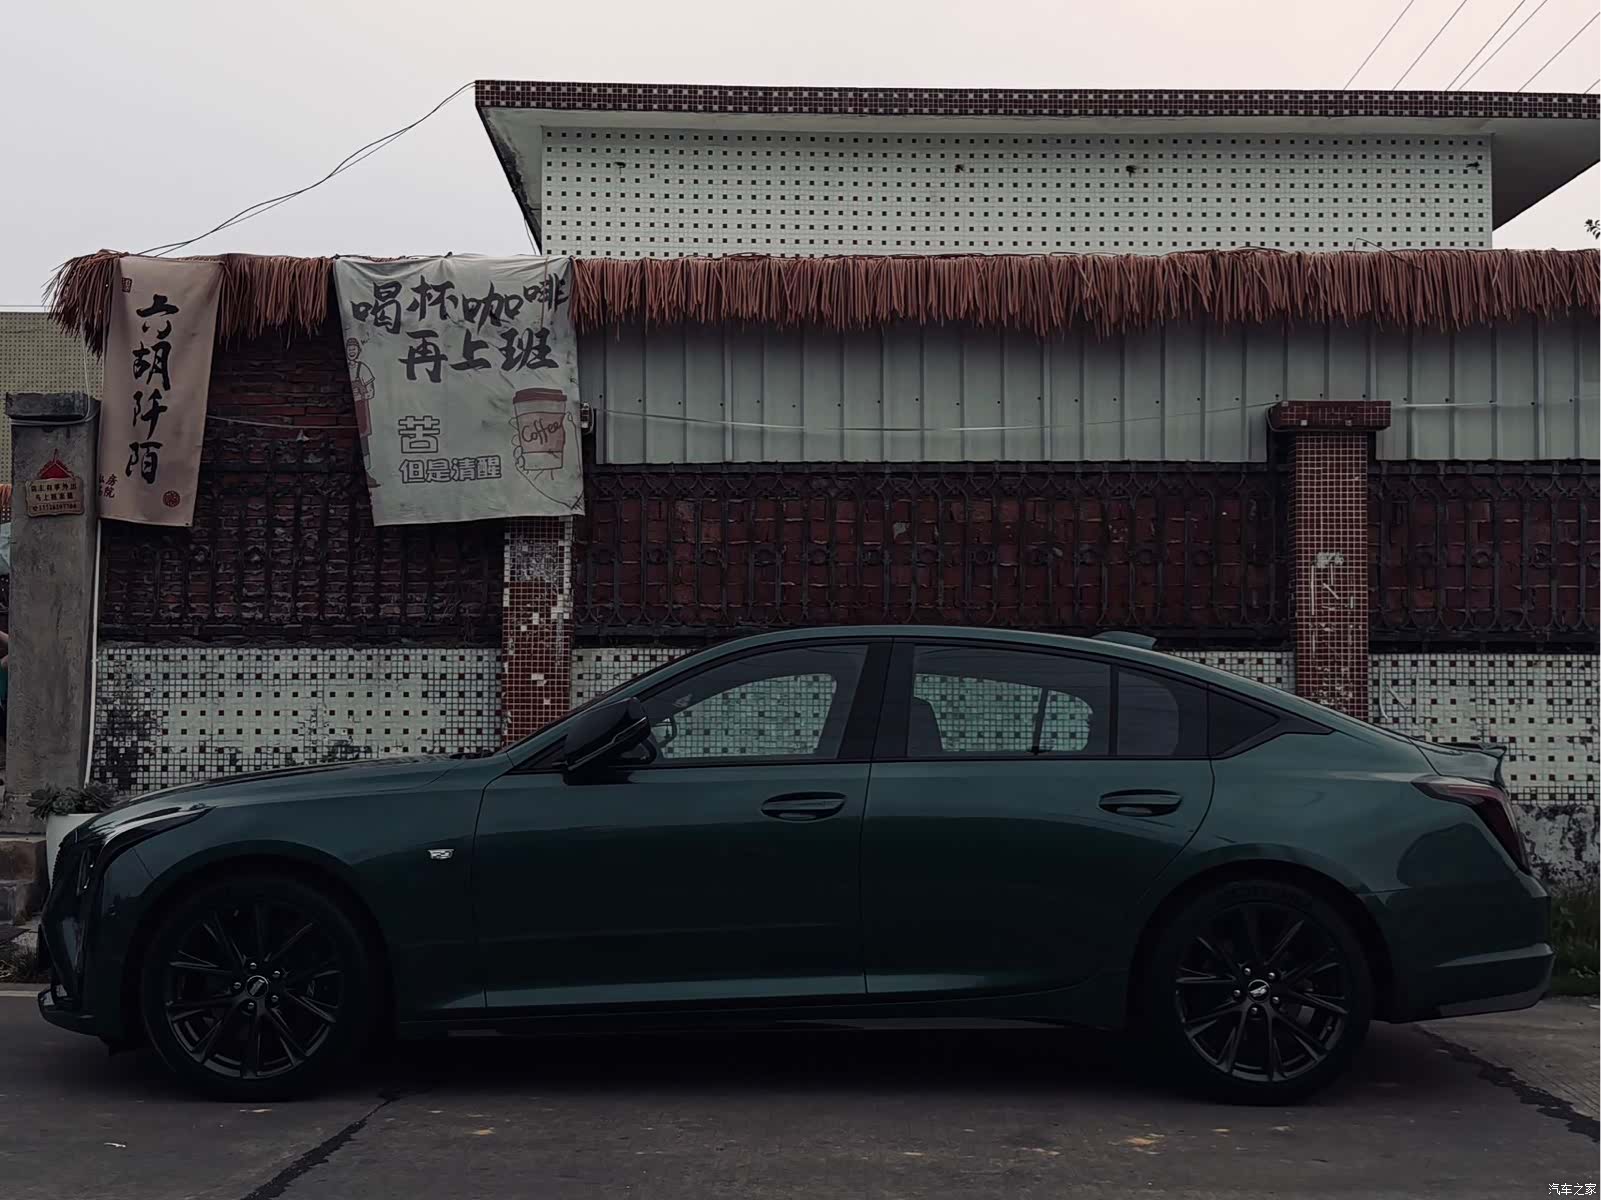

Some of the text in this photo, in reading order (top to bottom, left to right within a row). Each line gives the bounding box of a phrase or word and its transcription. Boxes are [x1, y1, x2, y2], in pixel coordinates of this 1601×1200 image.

[350, 275, 569, 334] 喝杯咖啡
[399, 329, 560, 384] 再上班
[398, 415, 441, 454] 苦
[521, 419, 562, 445] Coffee
[399, 455, 502, 484] 但是清醒
